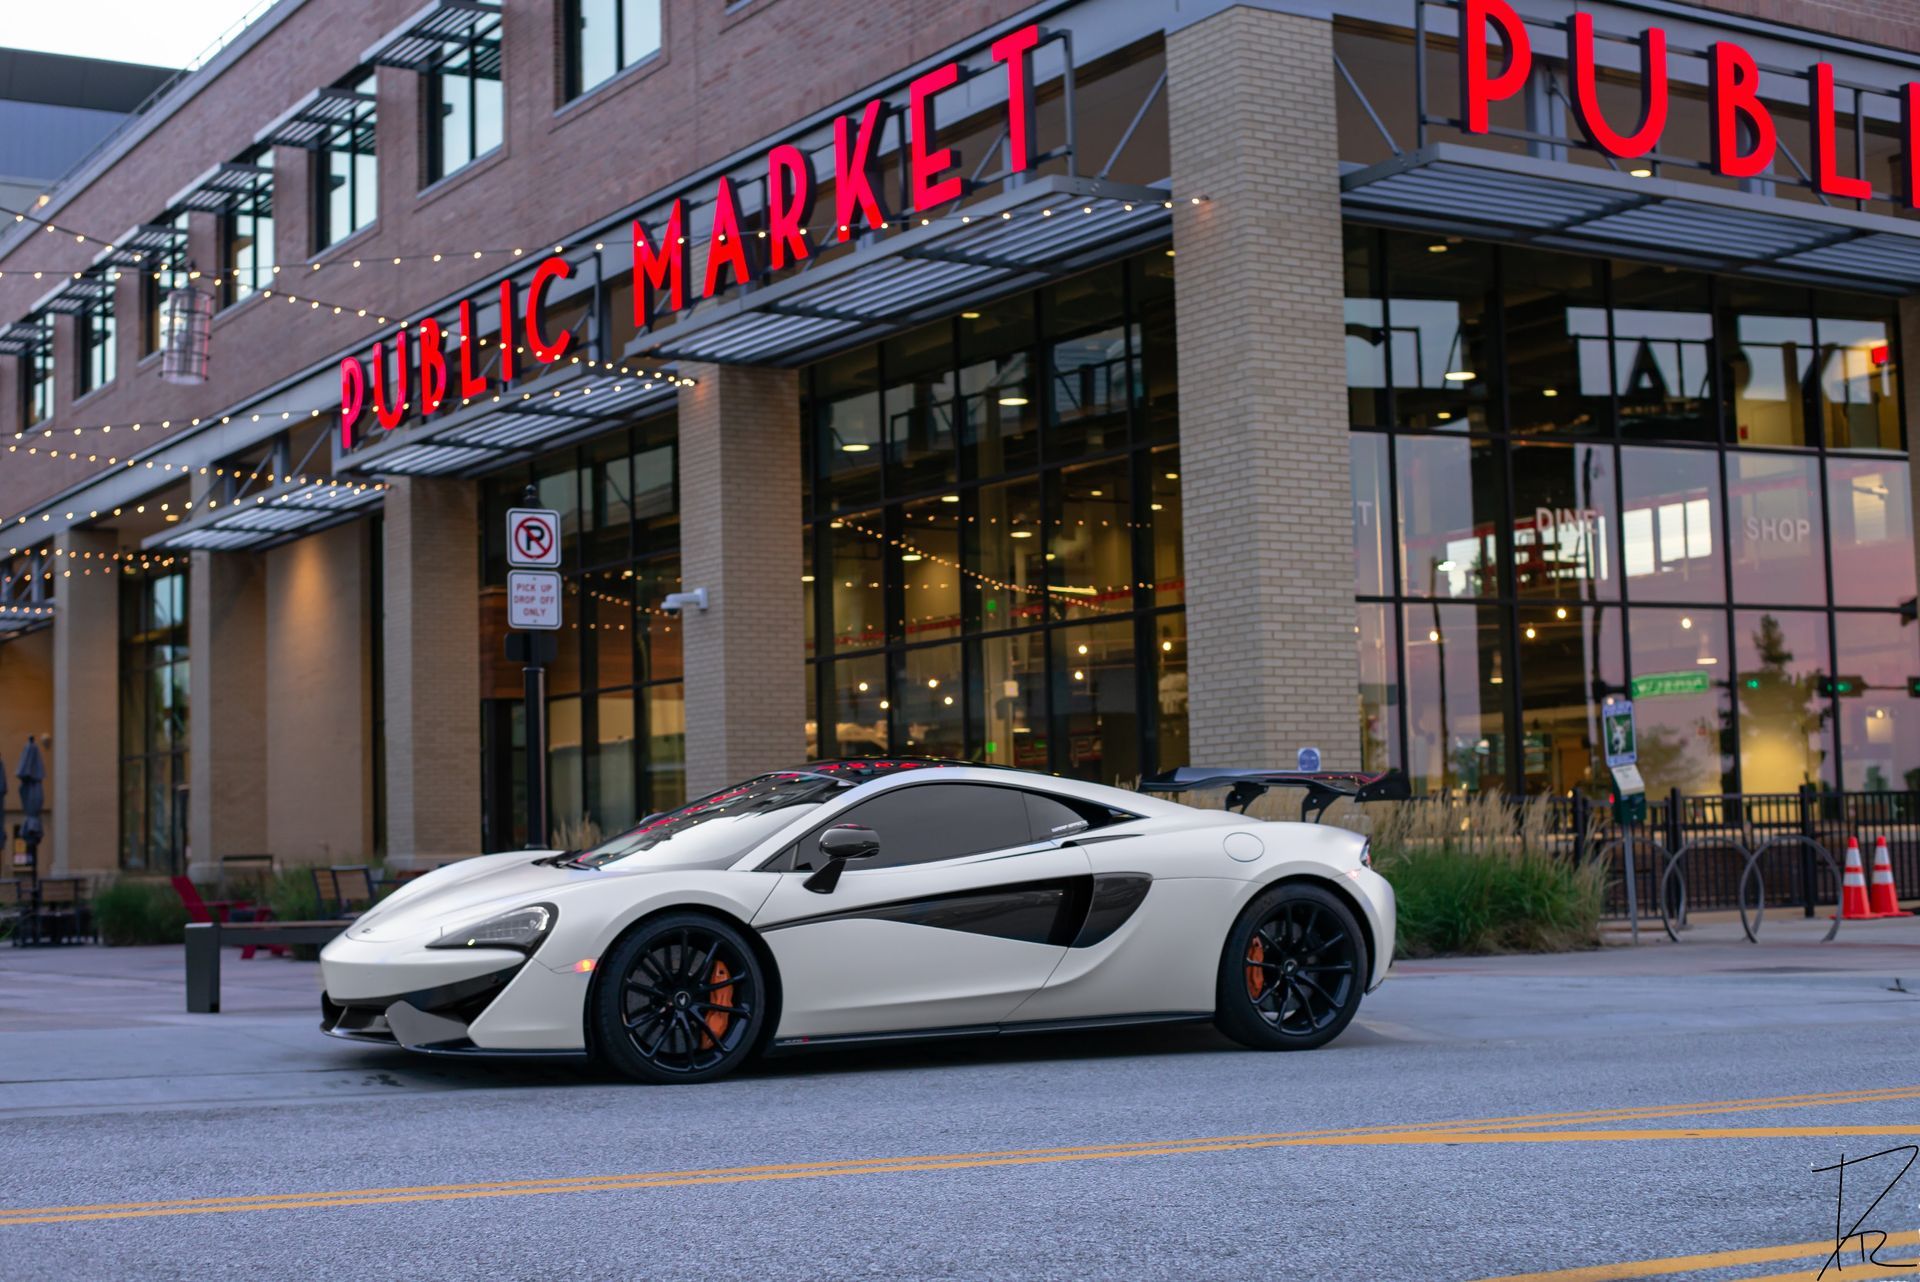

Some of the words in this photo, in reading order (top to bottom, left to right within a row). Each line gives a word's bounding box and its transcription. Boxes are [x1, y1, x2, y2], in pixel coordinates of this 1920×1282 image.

[340, 256, 575, 449] PUBLIC
[631, 24, 1042, 328] MARKET
[1536, 507, 1598, 534] DINE
[1746, 516, 1811, 542] SHOP
[516, 583, 537, 592] PICK
[540, 584, 553, 593] UP
[513, 595, 536, 604] DROP
[540, 596, 555, 605] OFF
[522, 607, 546, 617] ONLY
